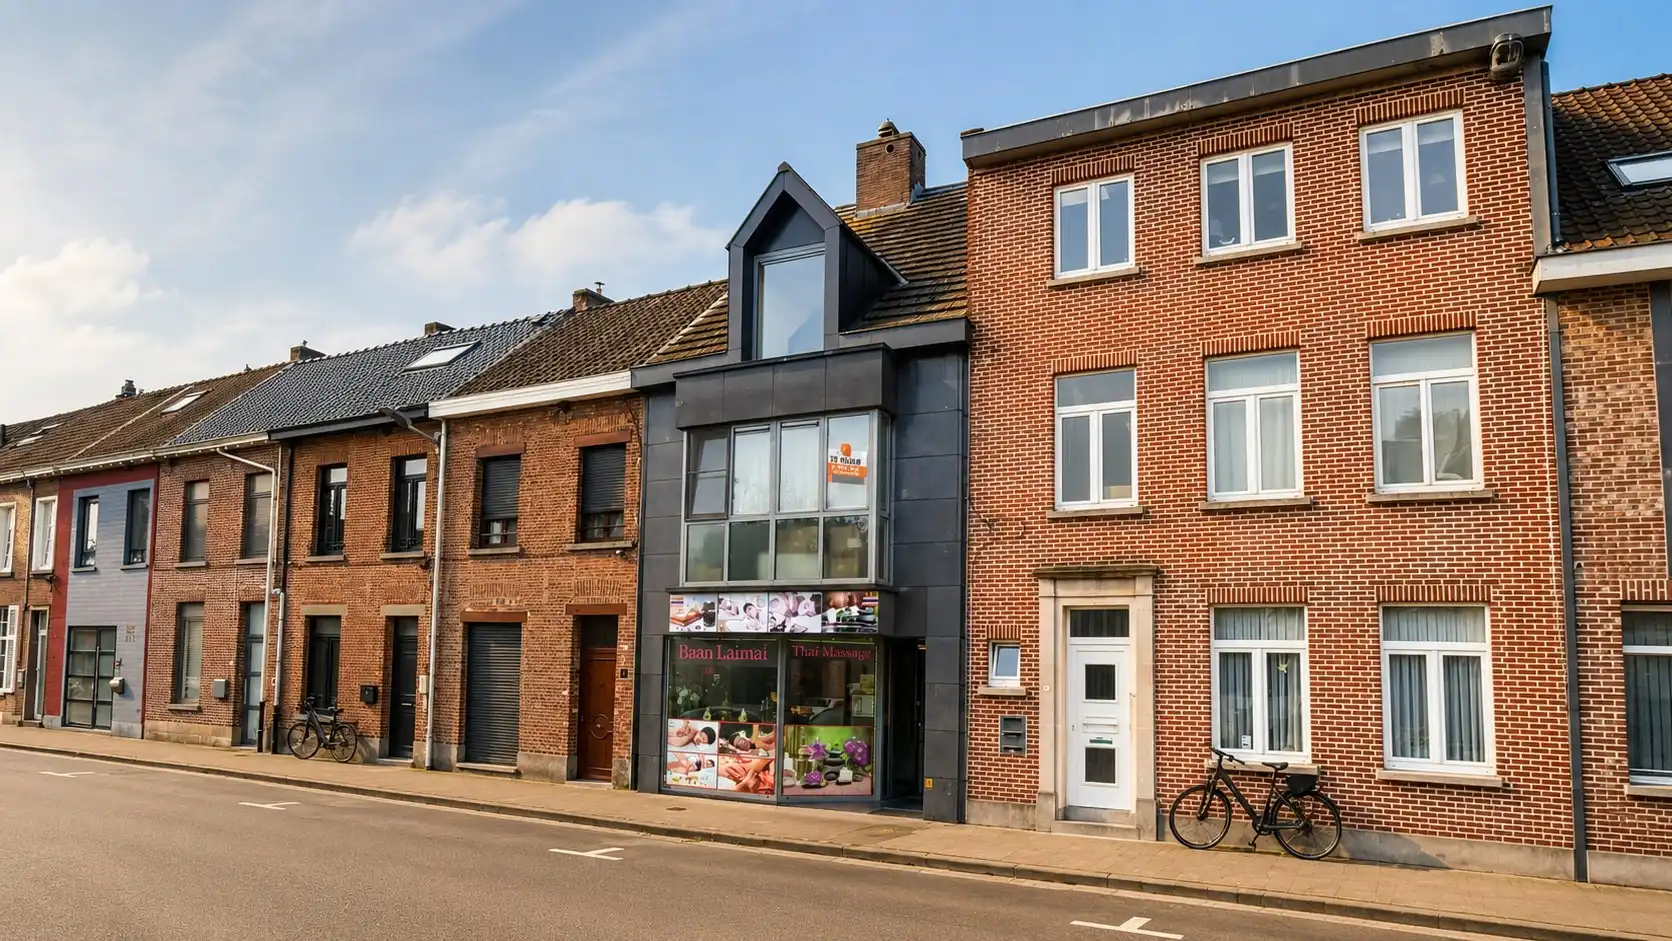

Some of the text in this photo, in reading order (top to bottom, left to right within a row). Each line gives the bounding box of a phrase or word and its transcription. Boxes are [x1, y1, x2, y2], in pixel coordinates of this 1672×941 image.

[679, 644, 768, 661] Baan Laimai
[792, 644, 820, 657] Thai
